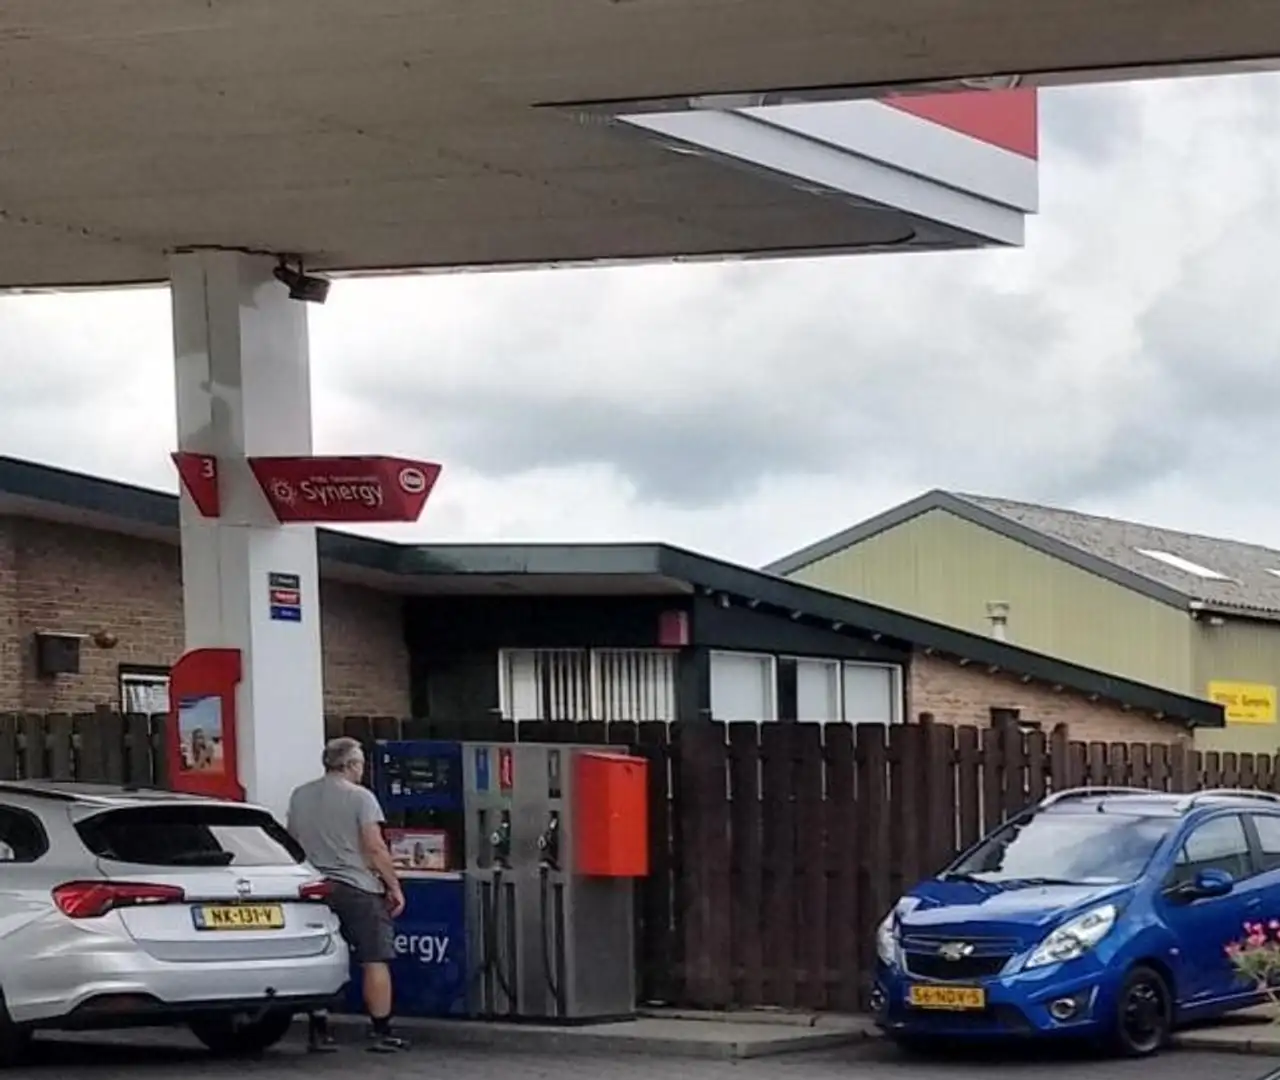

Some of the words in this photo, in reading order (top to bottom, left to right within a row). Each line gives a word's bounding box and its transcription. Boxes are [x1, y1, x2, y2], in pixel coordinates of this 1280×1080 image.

[202, 458, 214, 478] 3
[300, 481, 383, 507] Synergy
[394, 933, 449, 962] ergy
